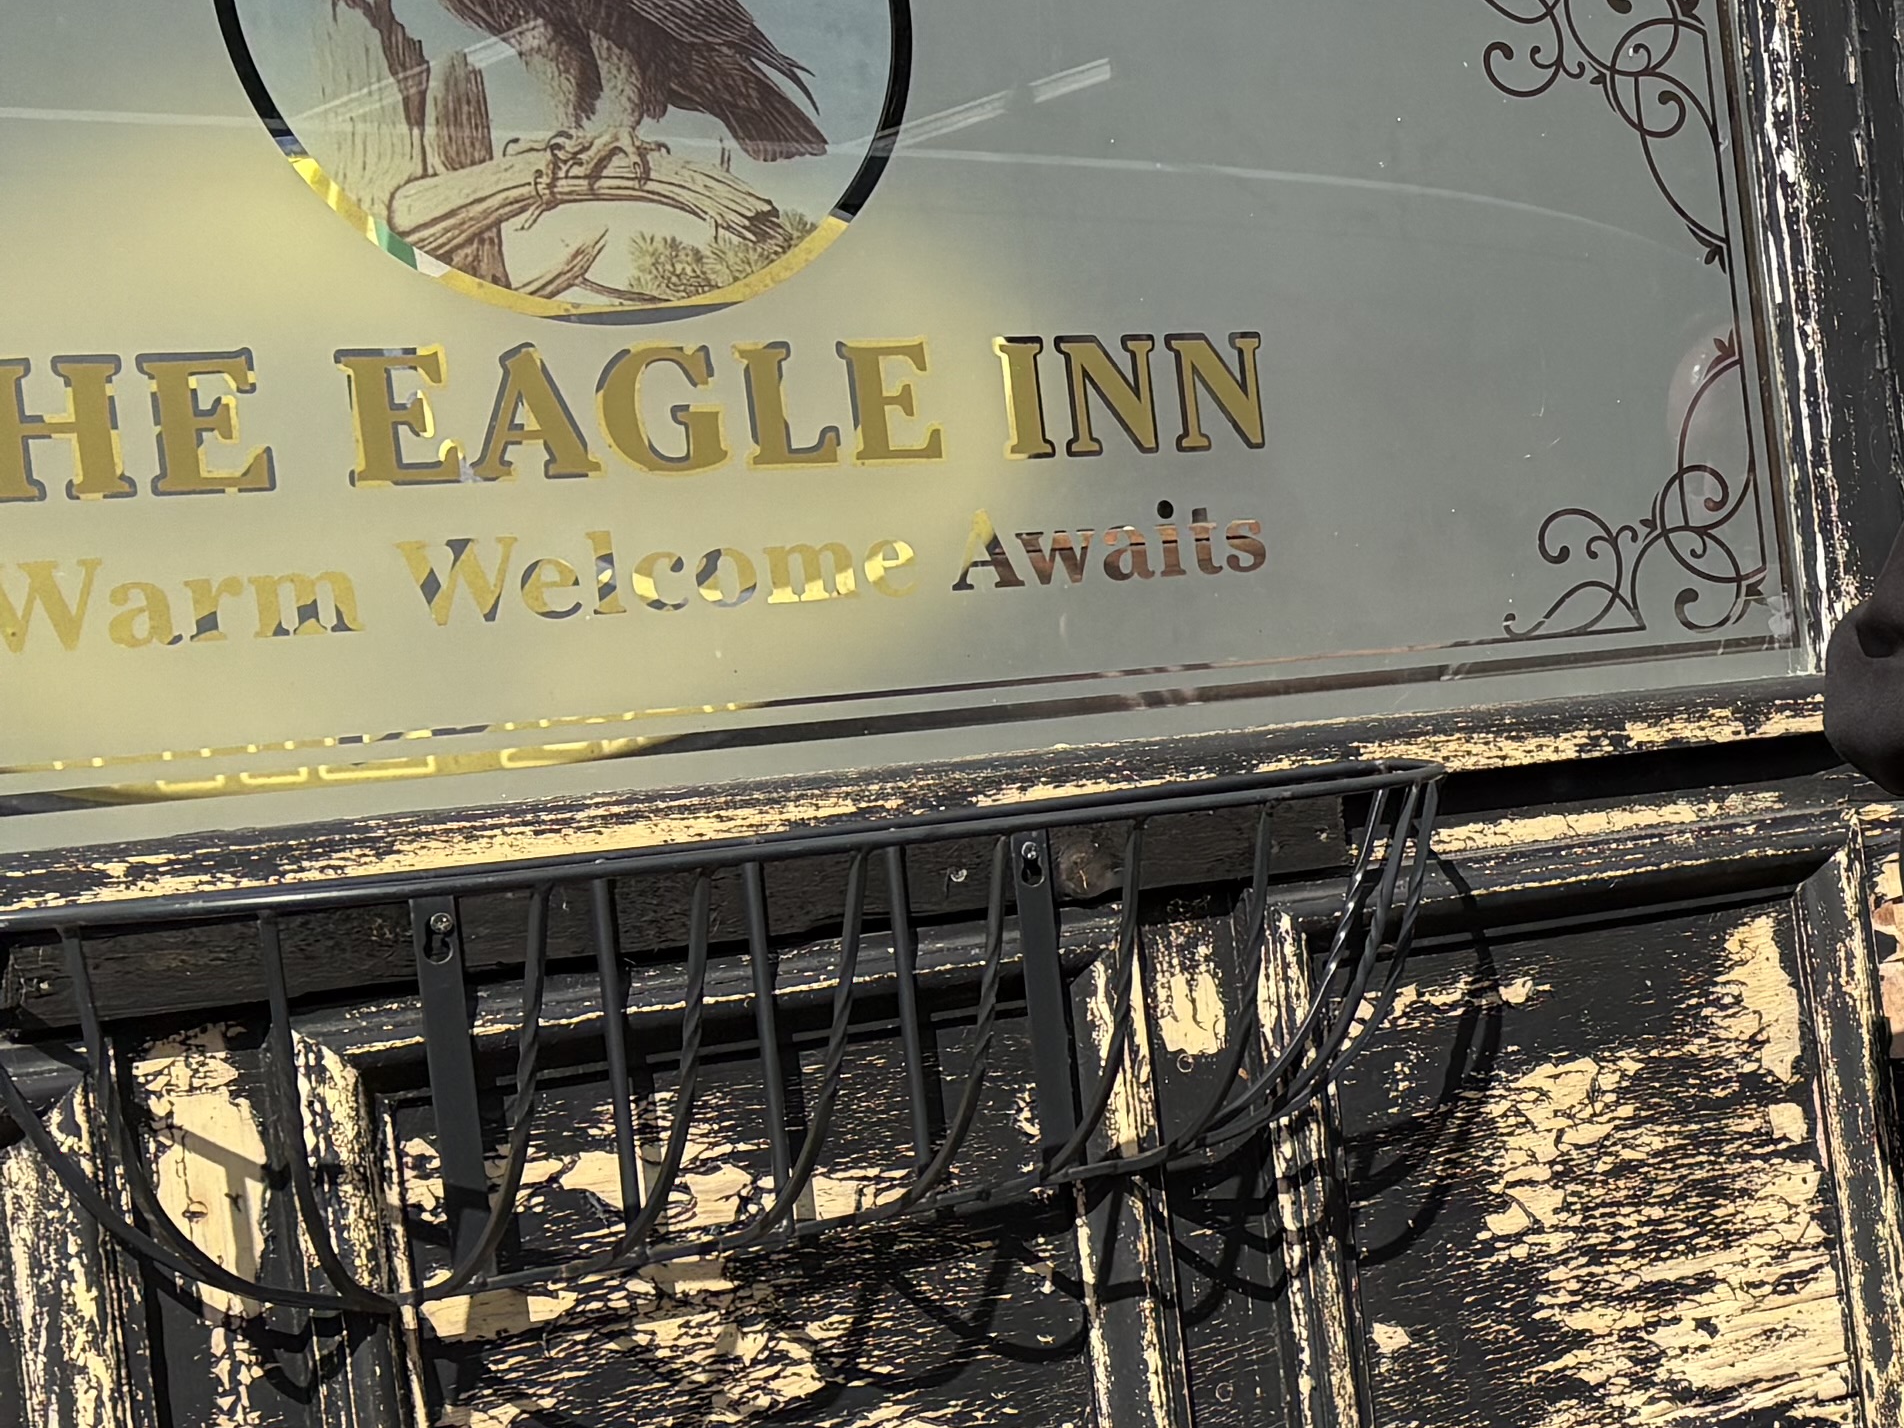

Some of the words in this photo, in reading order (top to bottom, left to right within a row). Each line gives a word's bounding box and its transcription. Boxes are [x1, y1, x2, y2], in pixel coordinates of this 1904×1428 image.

[334, 335, 947, 487] EAGLE
[993, 331, 1265, 460] INN
[0, 557, 365, 653] Warm
[395, 530, 917, 627] Welcome
[951, 499, 1267, 591] Awaits
